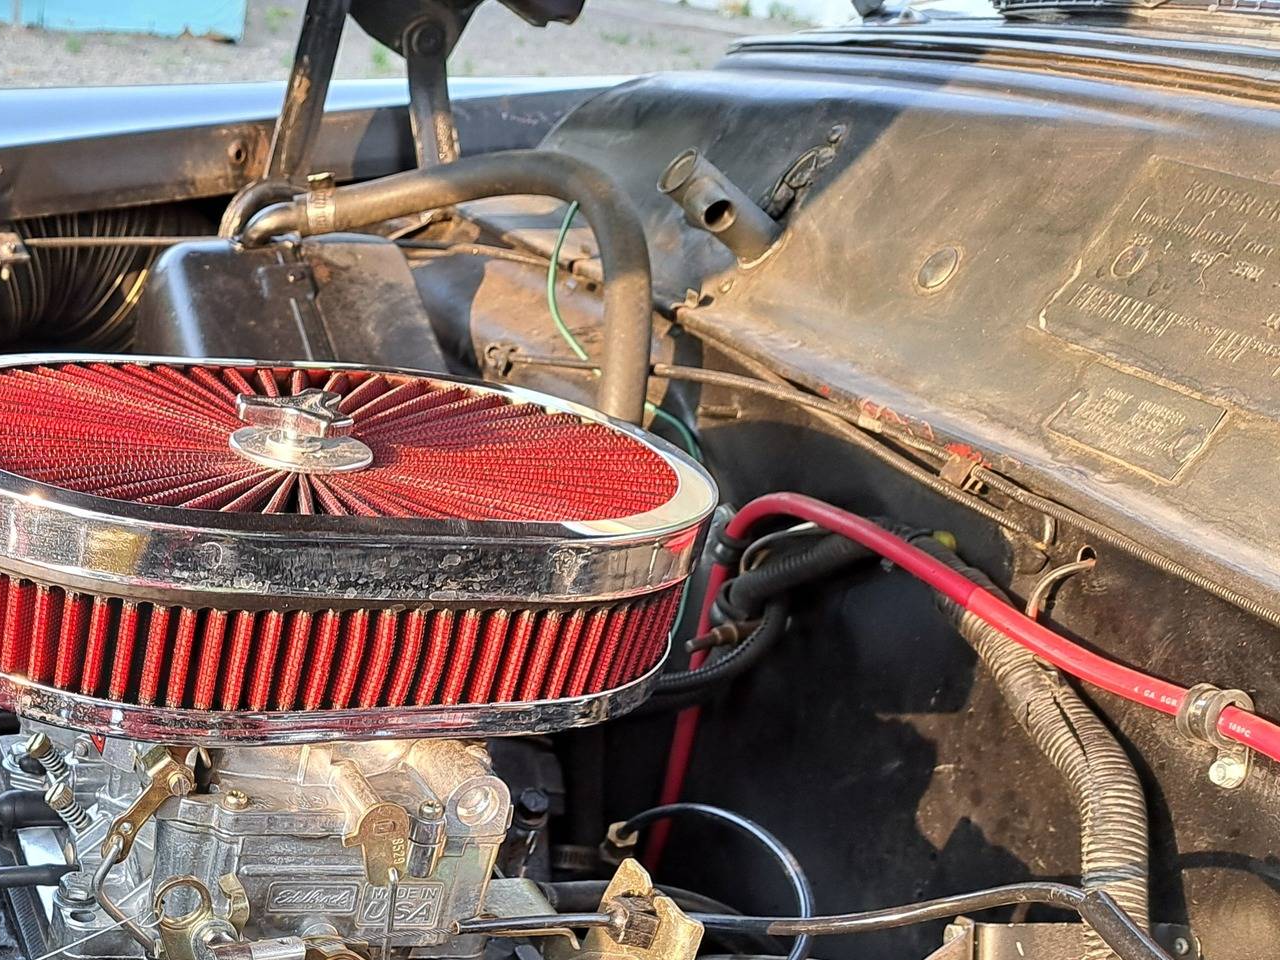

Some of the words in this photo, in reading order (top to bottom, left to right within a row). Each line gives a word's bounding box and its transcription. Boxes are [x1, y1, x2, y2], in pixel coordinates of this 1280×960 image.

[391, 837, 406, 865] 8529
[421, 887, 439, 900] IN
[363, 901, 434, 922] USA
